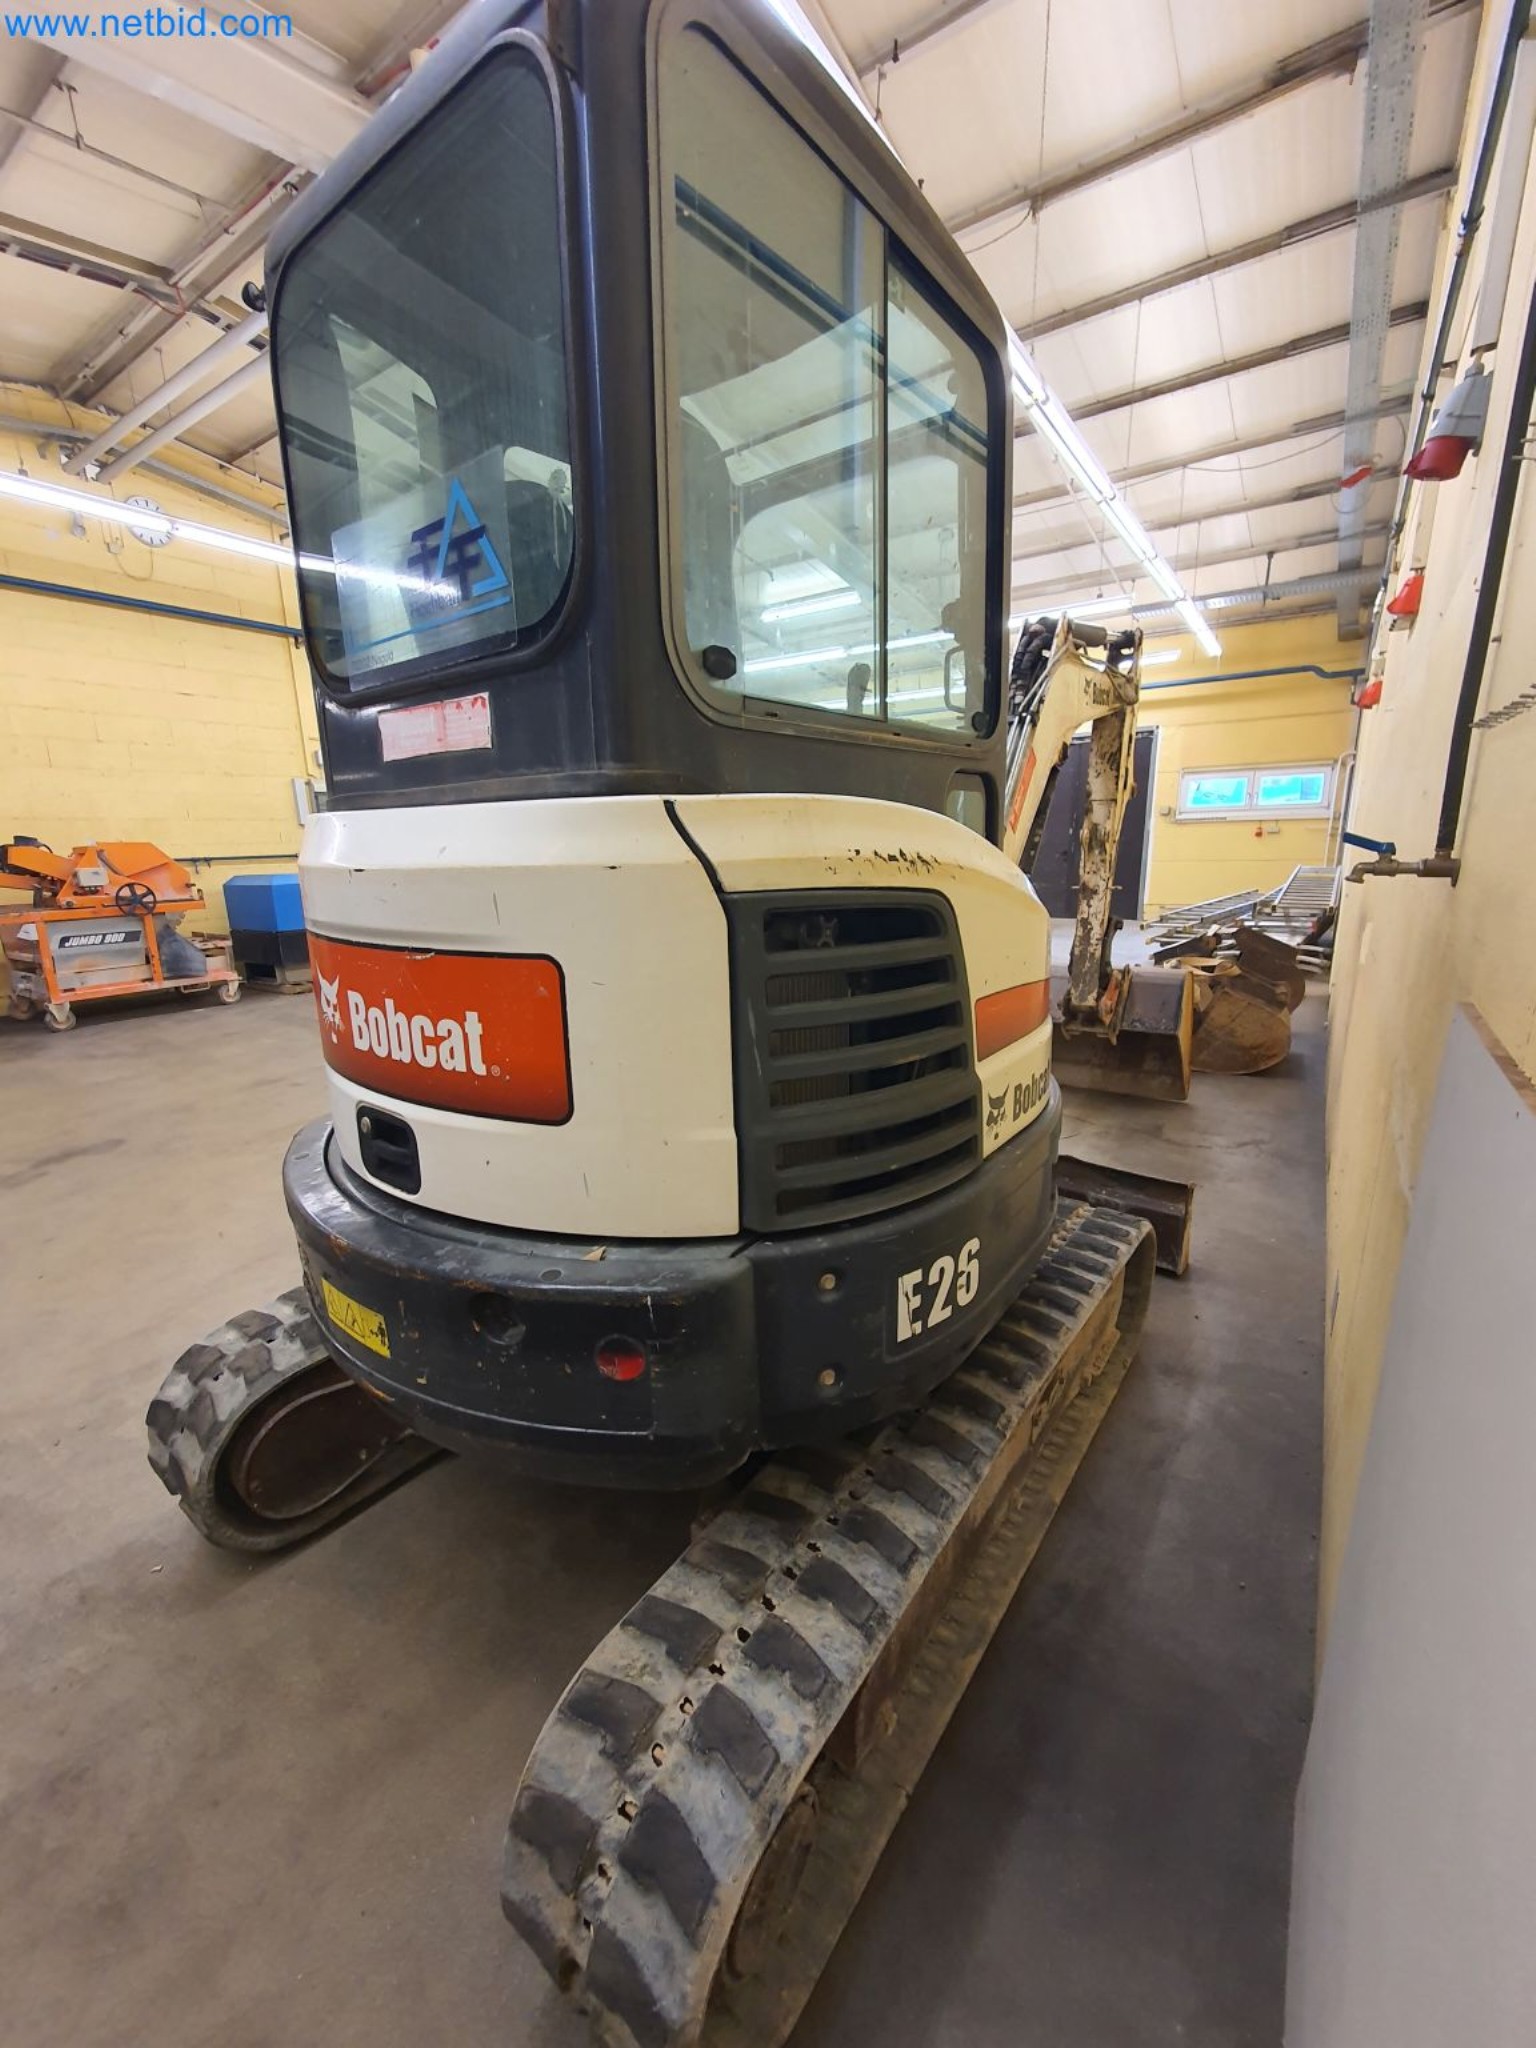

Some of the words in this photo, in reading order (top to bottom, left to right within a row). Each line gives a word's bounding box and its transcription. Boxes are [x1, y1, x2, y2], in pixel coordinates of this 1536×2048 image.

[64, 934, 103, 947] JUMBO
[347, 990, 487, 1076] Bobcat
[1012, 1067, 1050, 1122] Bobca
[897, 1237, 980, 1342] E26
